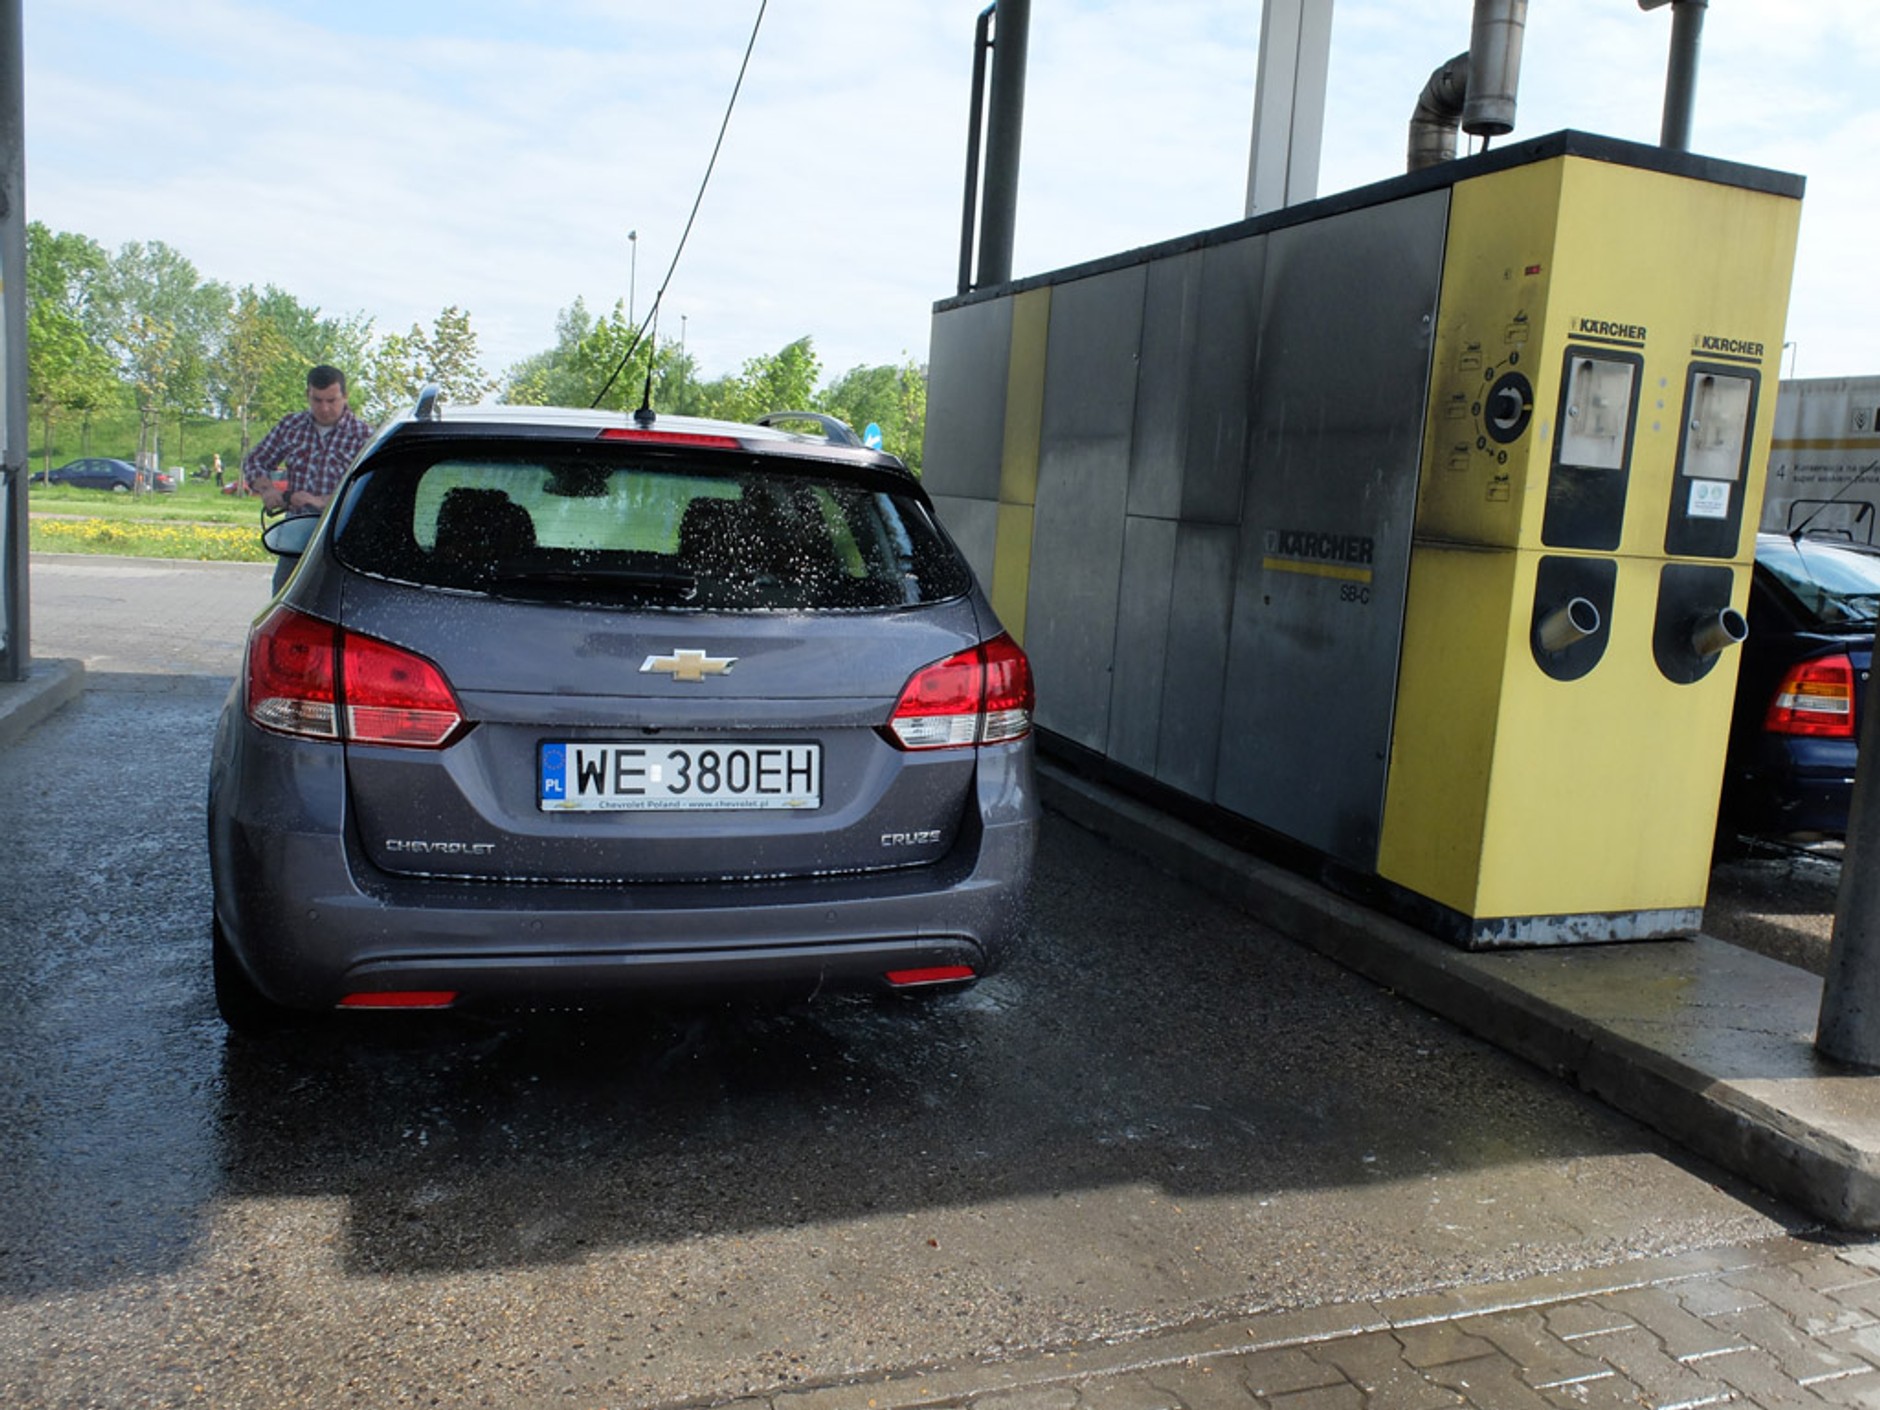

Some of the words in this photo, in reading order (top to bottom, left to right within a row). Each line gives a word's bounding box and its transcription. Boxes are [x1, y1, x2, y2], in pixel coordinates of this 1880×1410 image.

[1579, 317, 1647, 340] KÄRCHER
[1702, 335, 1764, 356] KÄRCHER
[1278, 529, 1375, 564] KÄRCHER
[1340, 584, 1371, 605] SB-C
[576, 749, 646, 796] WE
[666, 749, 813, 796] 380EH
[545, 779, 563, 793] PL
[598, 799, 645, 809] Chevrolet
[647, 799, 681, 809] Poland
[688, 799, 770, 809] www.chevrolet.pl
[385, 838, 497, 855] CHEVROLET
[880, 829, 942, 848] CRUZE
